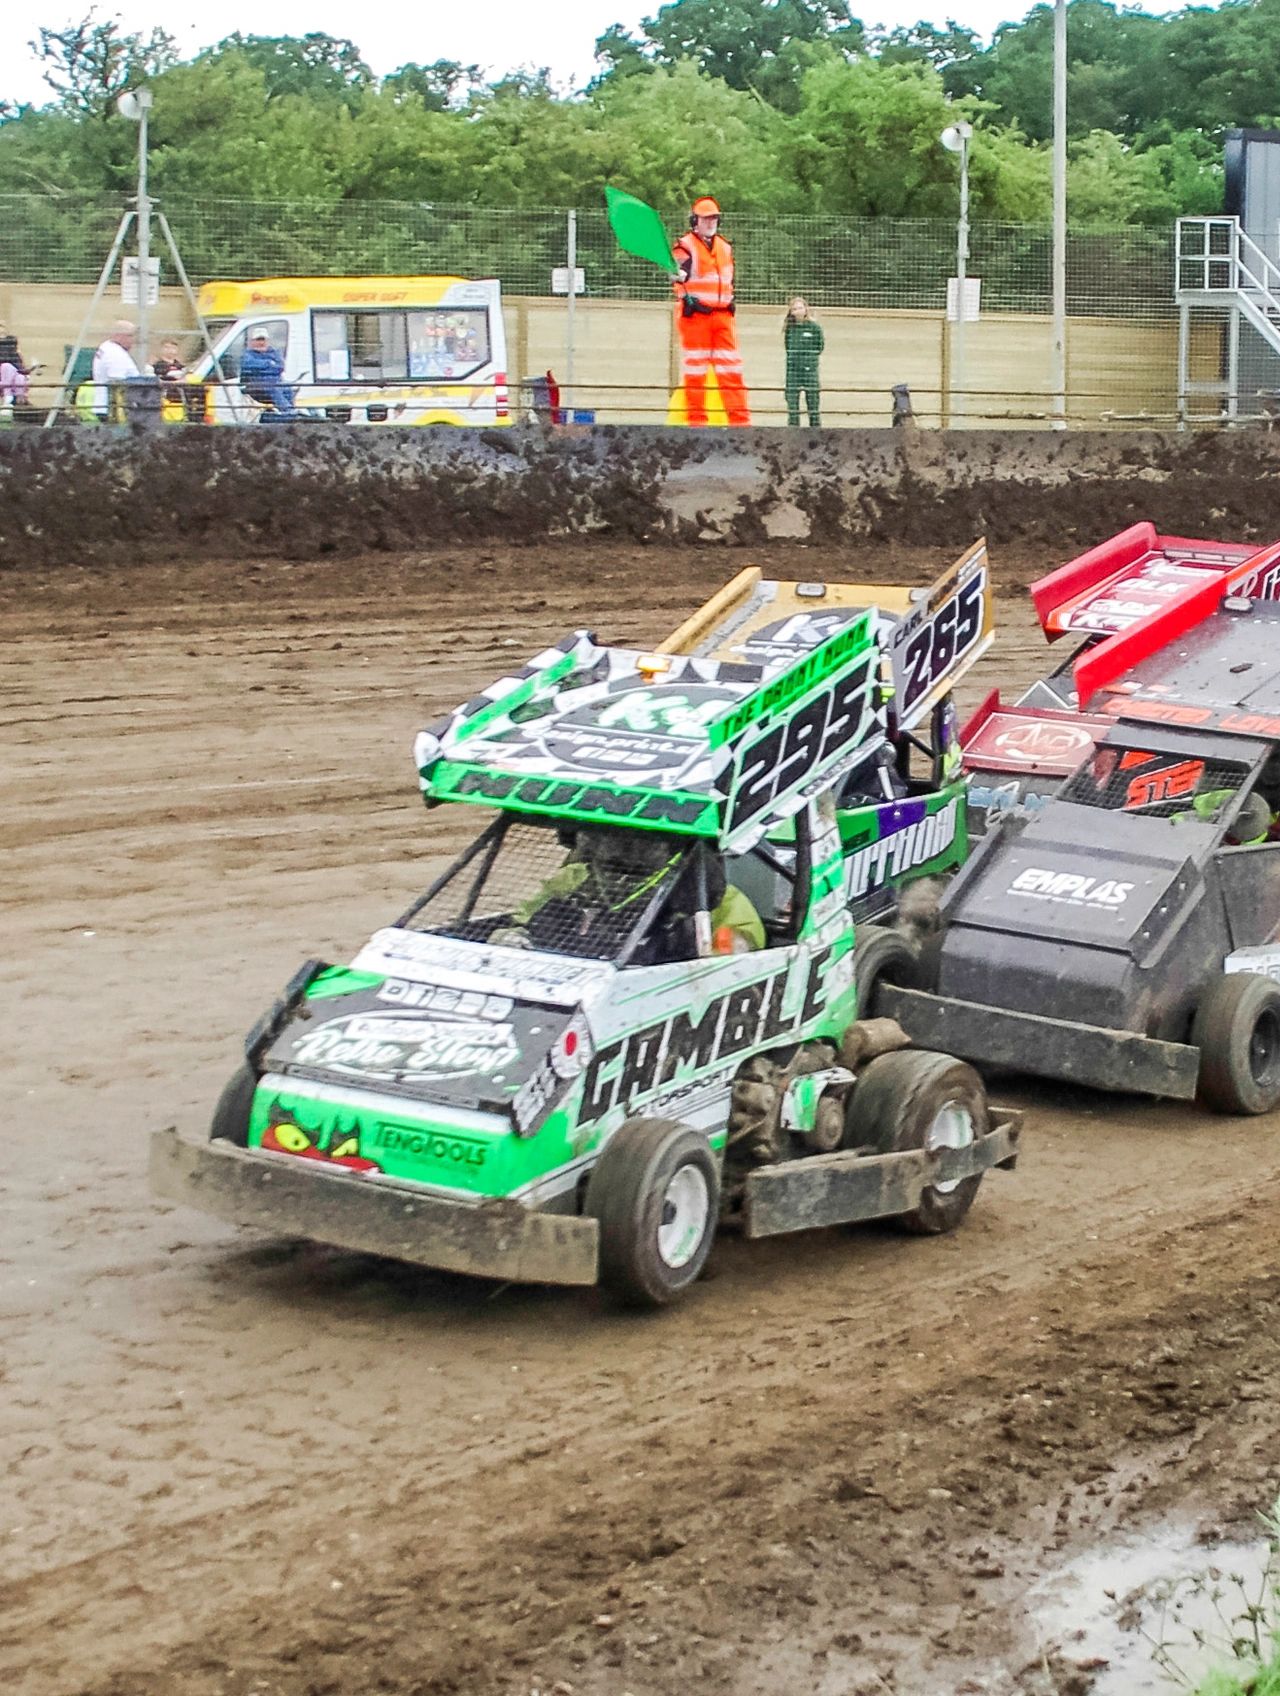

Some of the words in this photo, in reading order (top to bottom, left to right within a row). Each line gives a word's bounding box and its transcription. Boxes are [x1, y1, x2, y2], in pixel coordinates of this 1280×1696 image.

[902, 569, 985, 713] 265
[728, 656, 875, 836] 295
[455, 769, 709, 824] NUNN
[1011, 868, 1136, 903] EMPLAS
[291, 1028, 406, 1067] Retro
[405, 1037, 522, 1074] Shop
[576, 946, 832, 1127] GAMBLE
